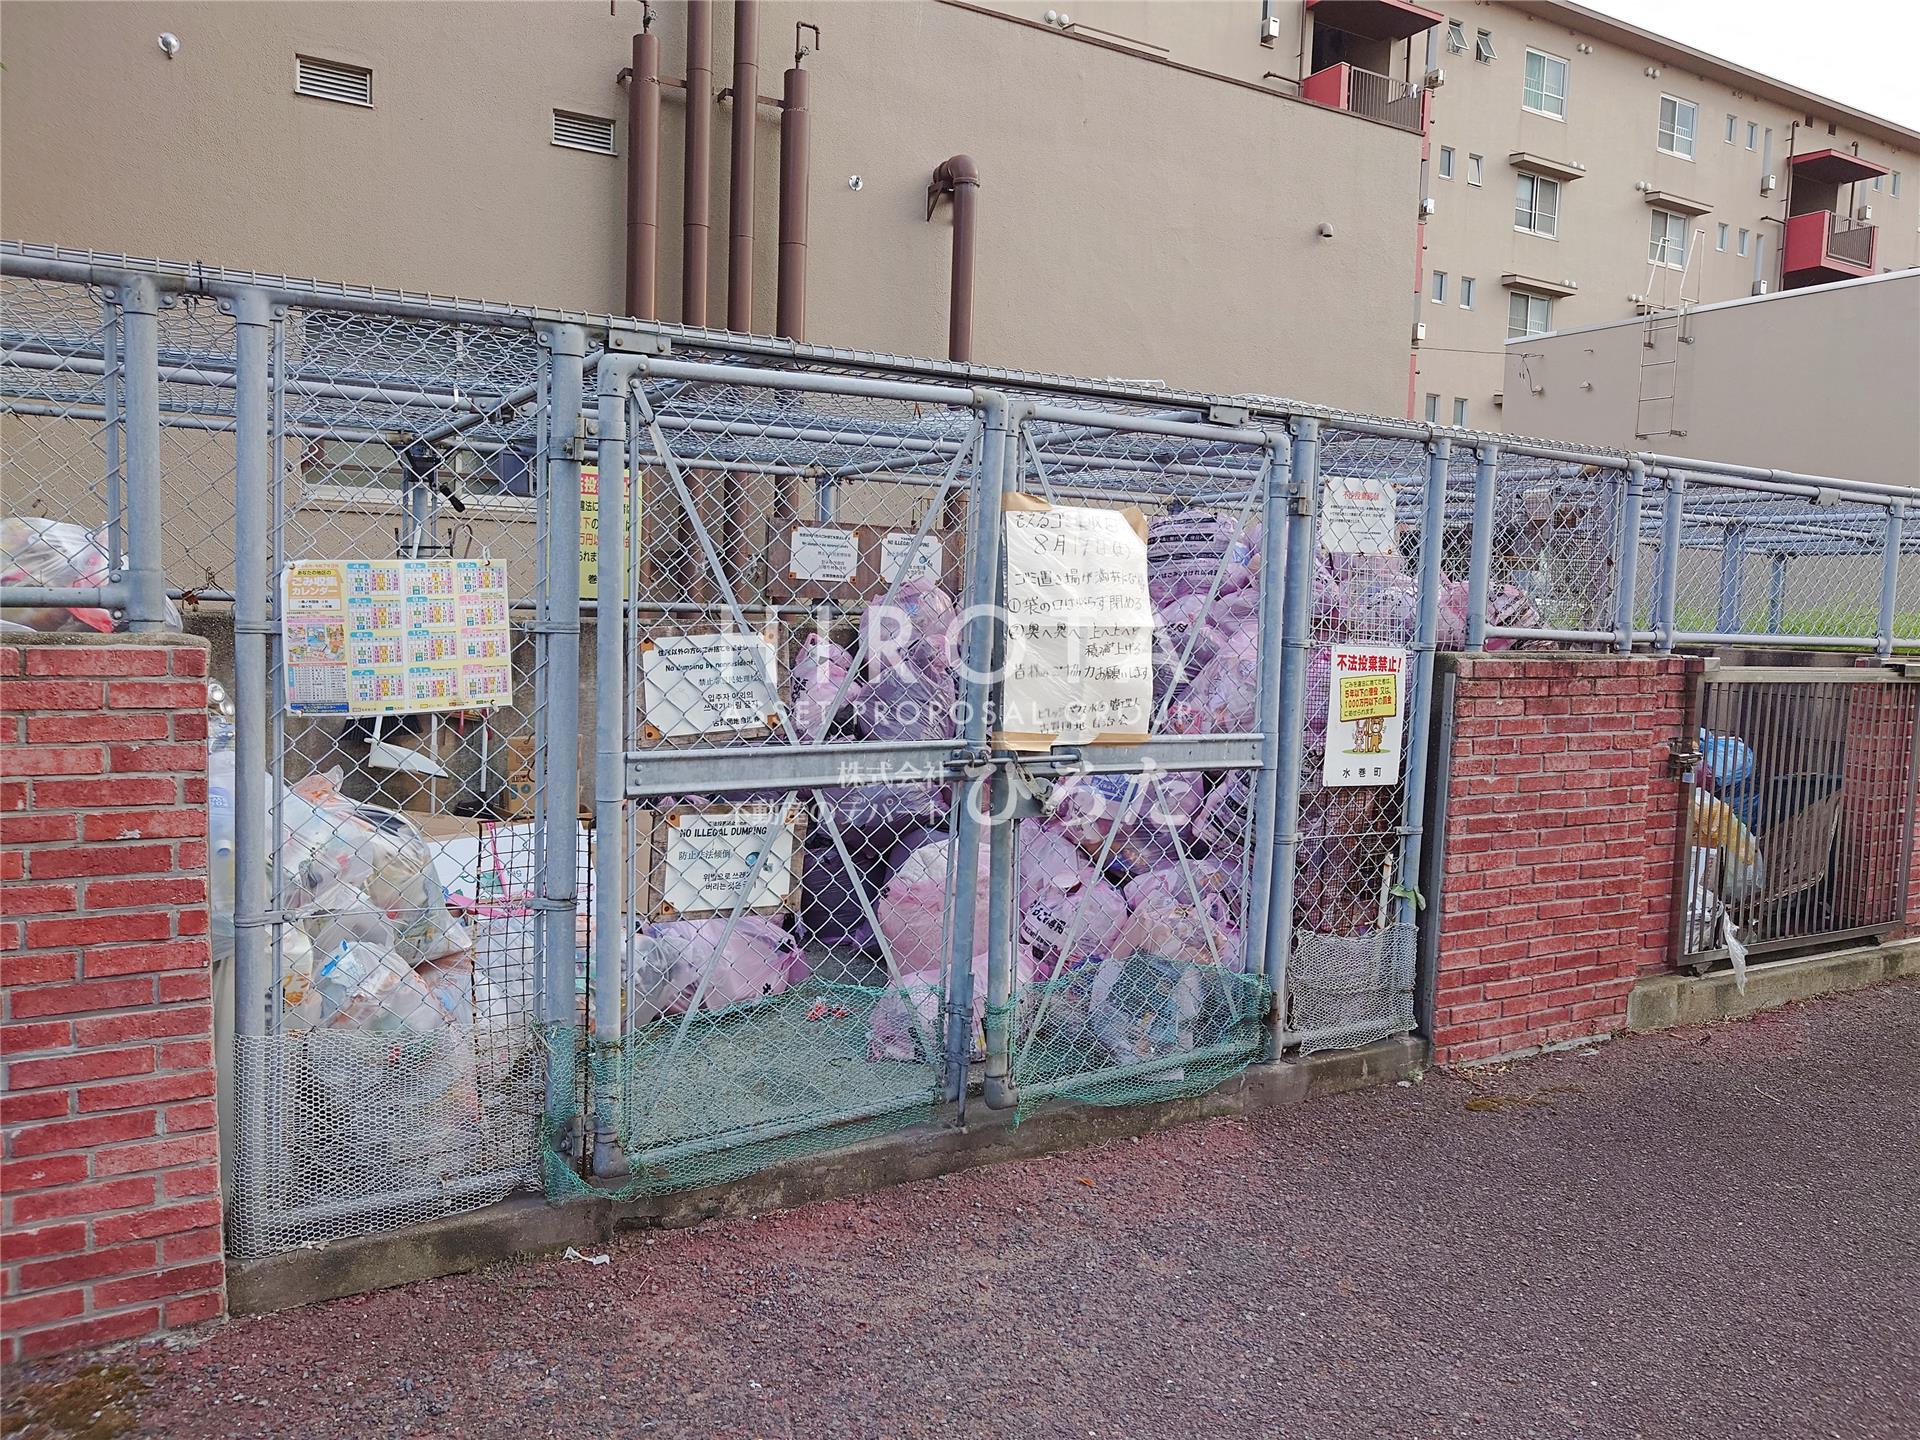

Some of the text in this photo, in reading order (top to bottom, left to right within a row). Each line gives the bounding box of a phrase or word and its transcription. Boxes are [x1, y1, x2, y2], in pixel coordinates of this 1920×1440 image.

[587, 574, 598, 585] 巻
[291, 586, 337, 596] カレンダー
[665, 664, 675, 672] No
[1336, 653, 1402, 673] 不法投棄禁止!
[707, 693, 730, 703] 입주자
[1342, 767, 1382, 778] 水巻町
[679, 826, 767, 838] NO ILLEGAL DUMPING
